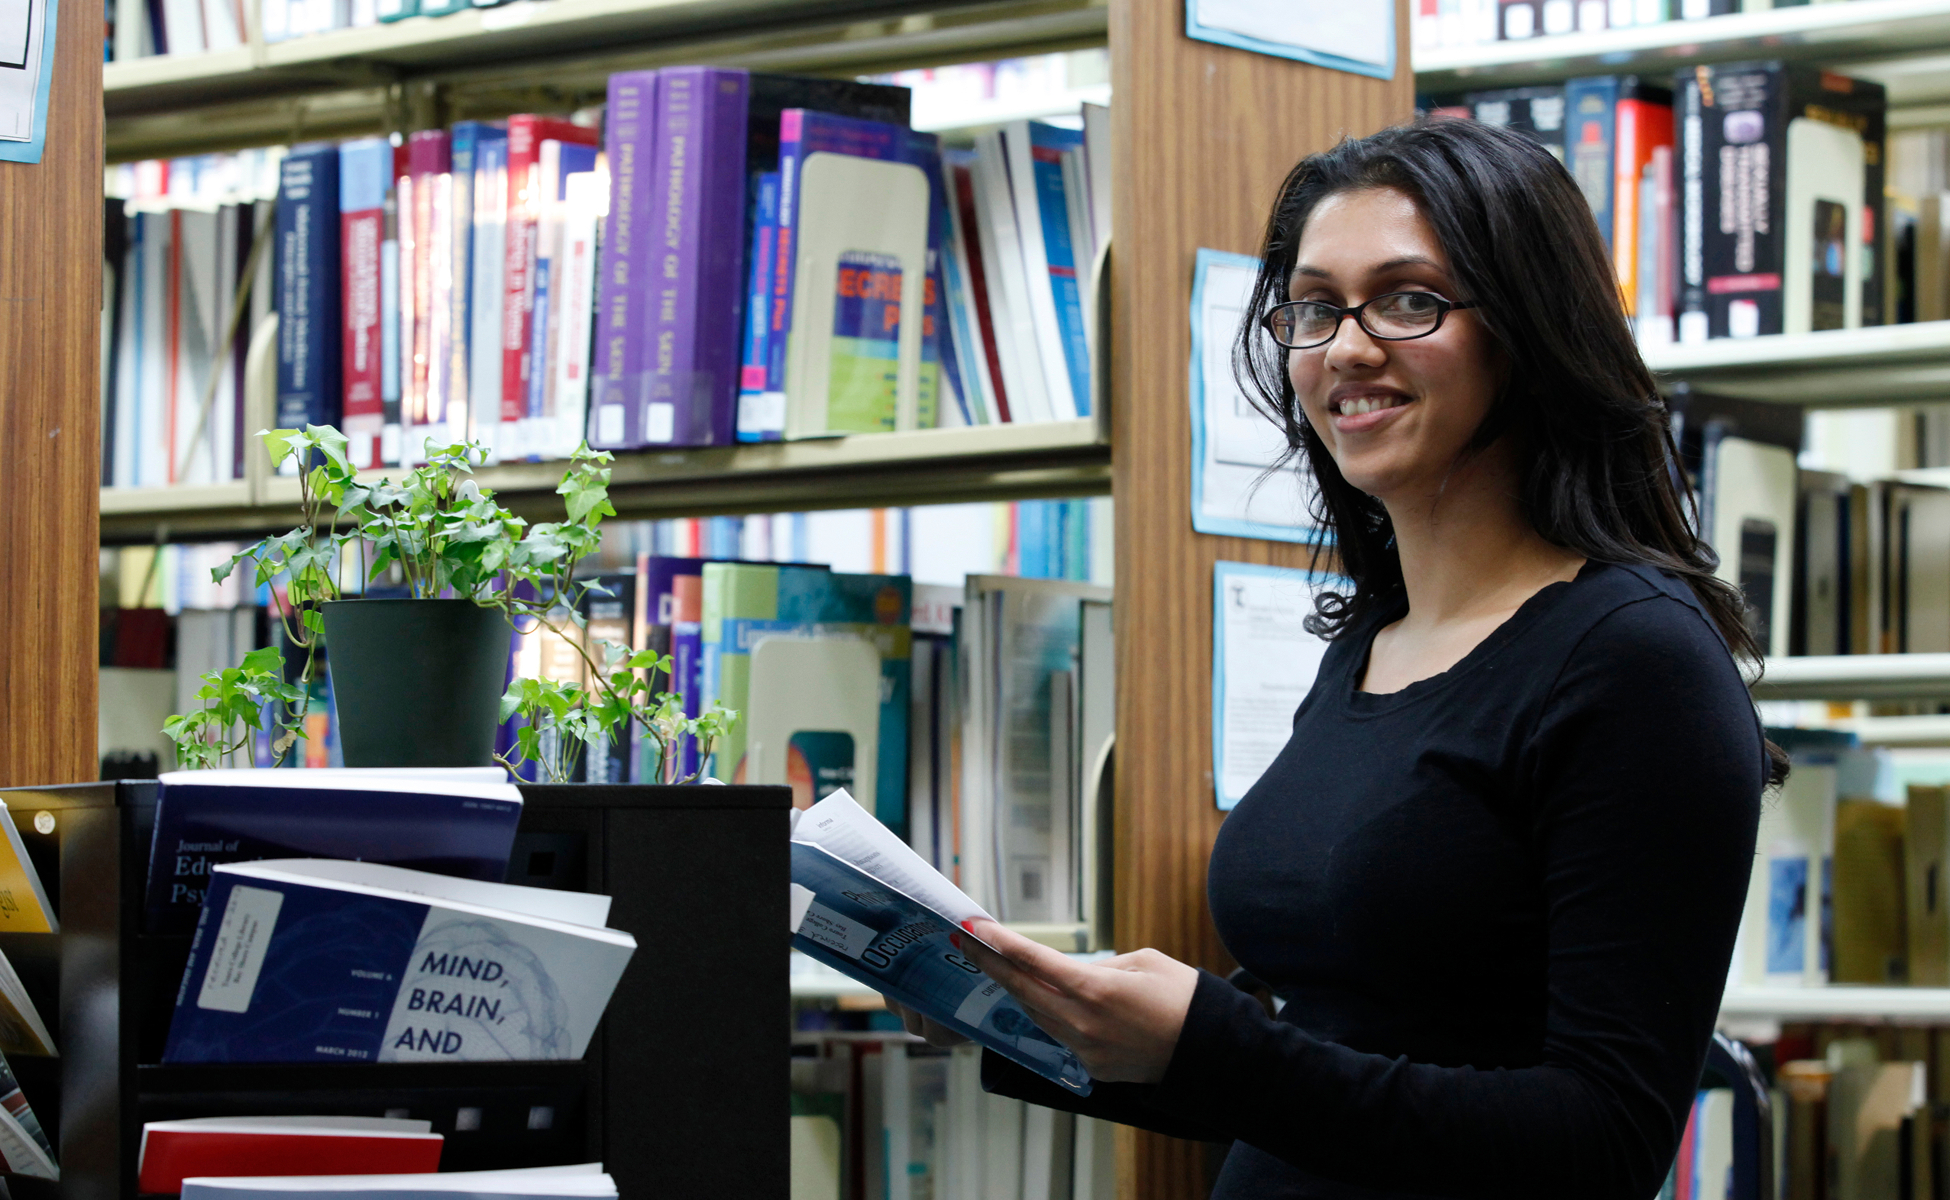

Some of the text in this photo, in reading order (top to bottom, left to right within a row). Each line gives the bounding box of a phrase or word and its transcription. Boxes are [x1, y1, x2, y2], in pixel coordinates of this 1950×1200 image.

[614, 143, 635, 256] PATHOLOGY
[665, 136, 686, 249] PATHOLOGY
[612, 263, 630, 285] OF
[662, 254, 680, 279] OF
[659, 288, 677, 322] THE
[176, 839, 240, 853] Journal of
[171, 883, 206, 907] Psy
[806, 917, 848, 941] Touro College
[816, 914, 835, 926] Shore
[834, 922, 847, 932] Bay
[351, 969, 384, 981] VOLUME
[420, 950, 509, 989] MIND,
[337, 1007, 372, 1019] NUMBER
[407, 987, 505, 1026] BRAIN,
[314, 1045, 368, 1060] MARCH 2012
[393, 1026, 463, 1055] AND
